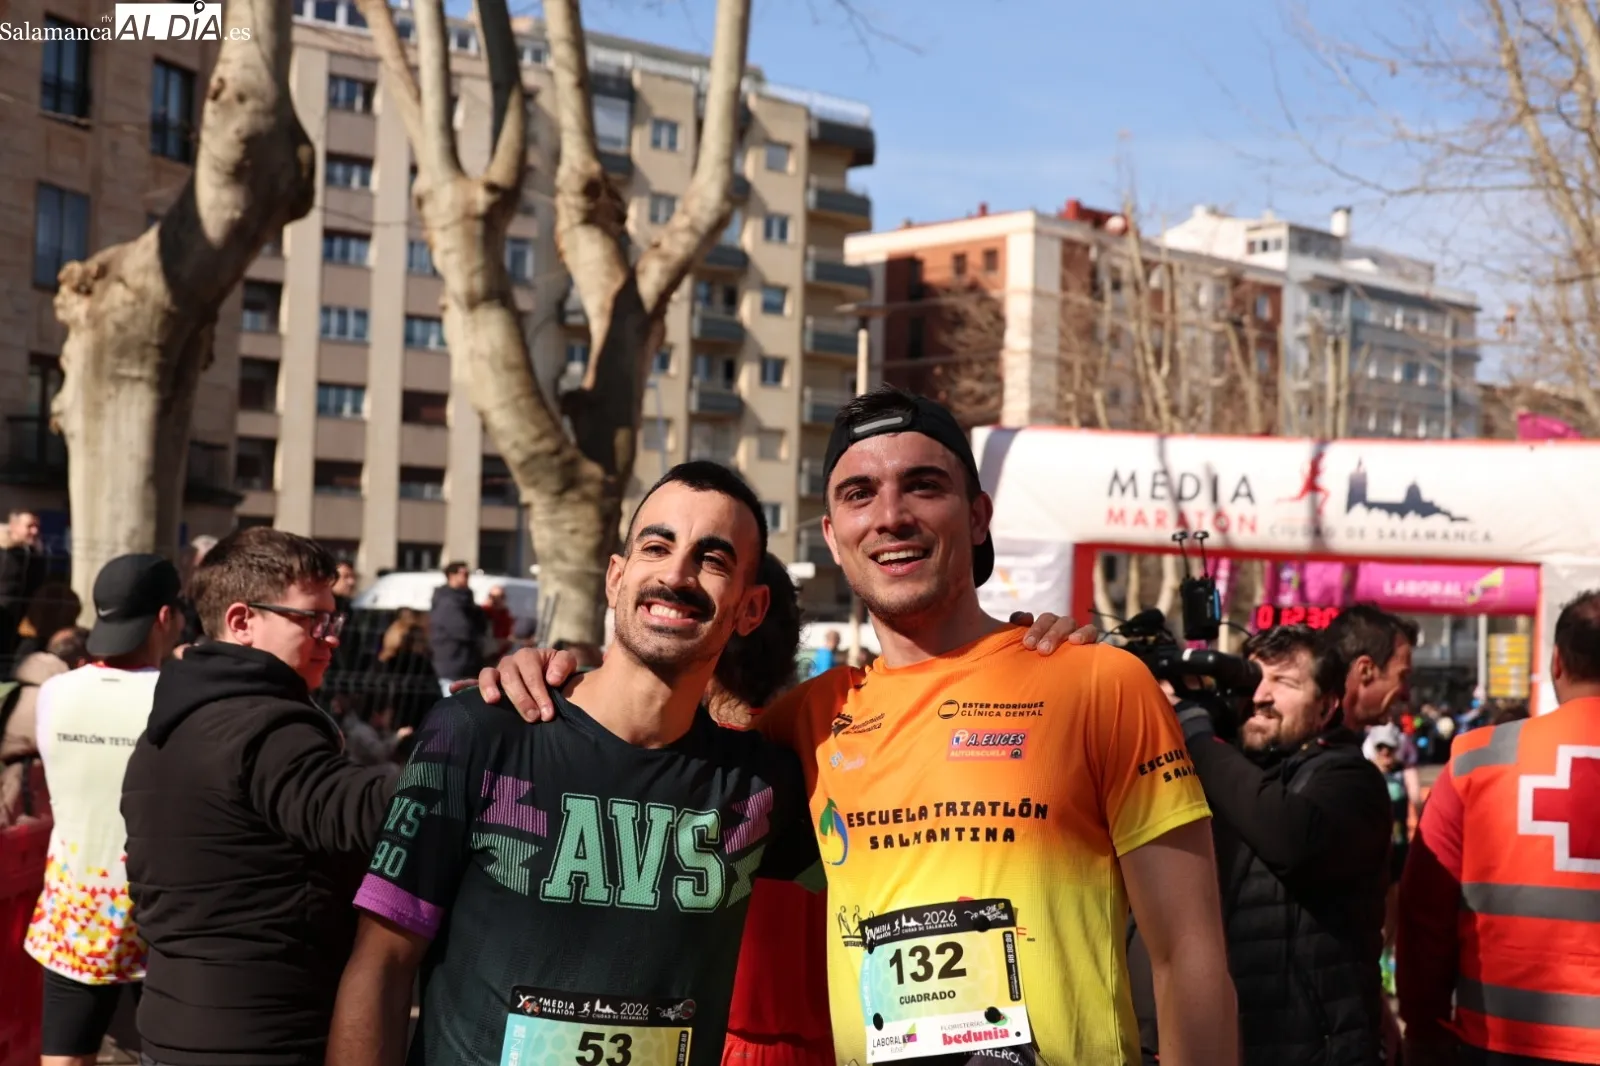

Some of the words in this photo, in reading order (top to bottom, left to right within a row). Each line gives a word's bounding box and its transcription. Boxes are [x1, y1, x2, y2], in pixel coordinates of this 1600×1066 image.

[1108, 469, 1256, 504] MEDIA
[1269, 525, 1335, 539] CIUDAD
[1346, 526, 1366, 539] DE
[1378, 528, 1493, 543] SALAMANCA
[960, 708, 1001, 717] CLÍNICA
[981, 733, 1025, 747] ELICES
[950, 749, 1006, 757] AUTOESCUELA
[846, 805, 928, 828] ESCUELA
[933, 797, 1049, 820] TRIATLÓN
[869, 827, 1016, 850] SALMANTINA
[540, 792, 726, 913] AVS
[923, 909, 957, 926] 2026
[889, 941, 967, 986] 132
[542, 998, 575, 1010] MEDIA
[899, 989, 957, 1005] CUADRADO
[620, 1003, 649, 1016] 2026
[872, 1035, 902, 1048] LABORAL
[942, 1027, 1009, 1046] bedunia
[576, 1031, 633, 1066] 53
